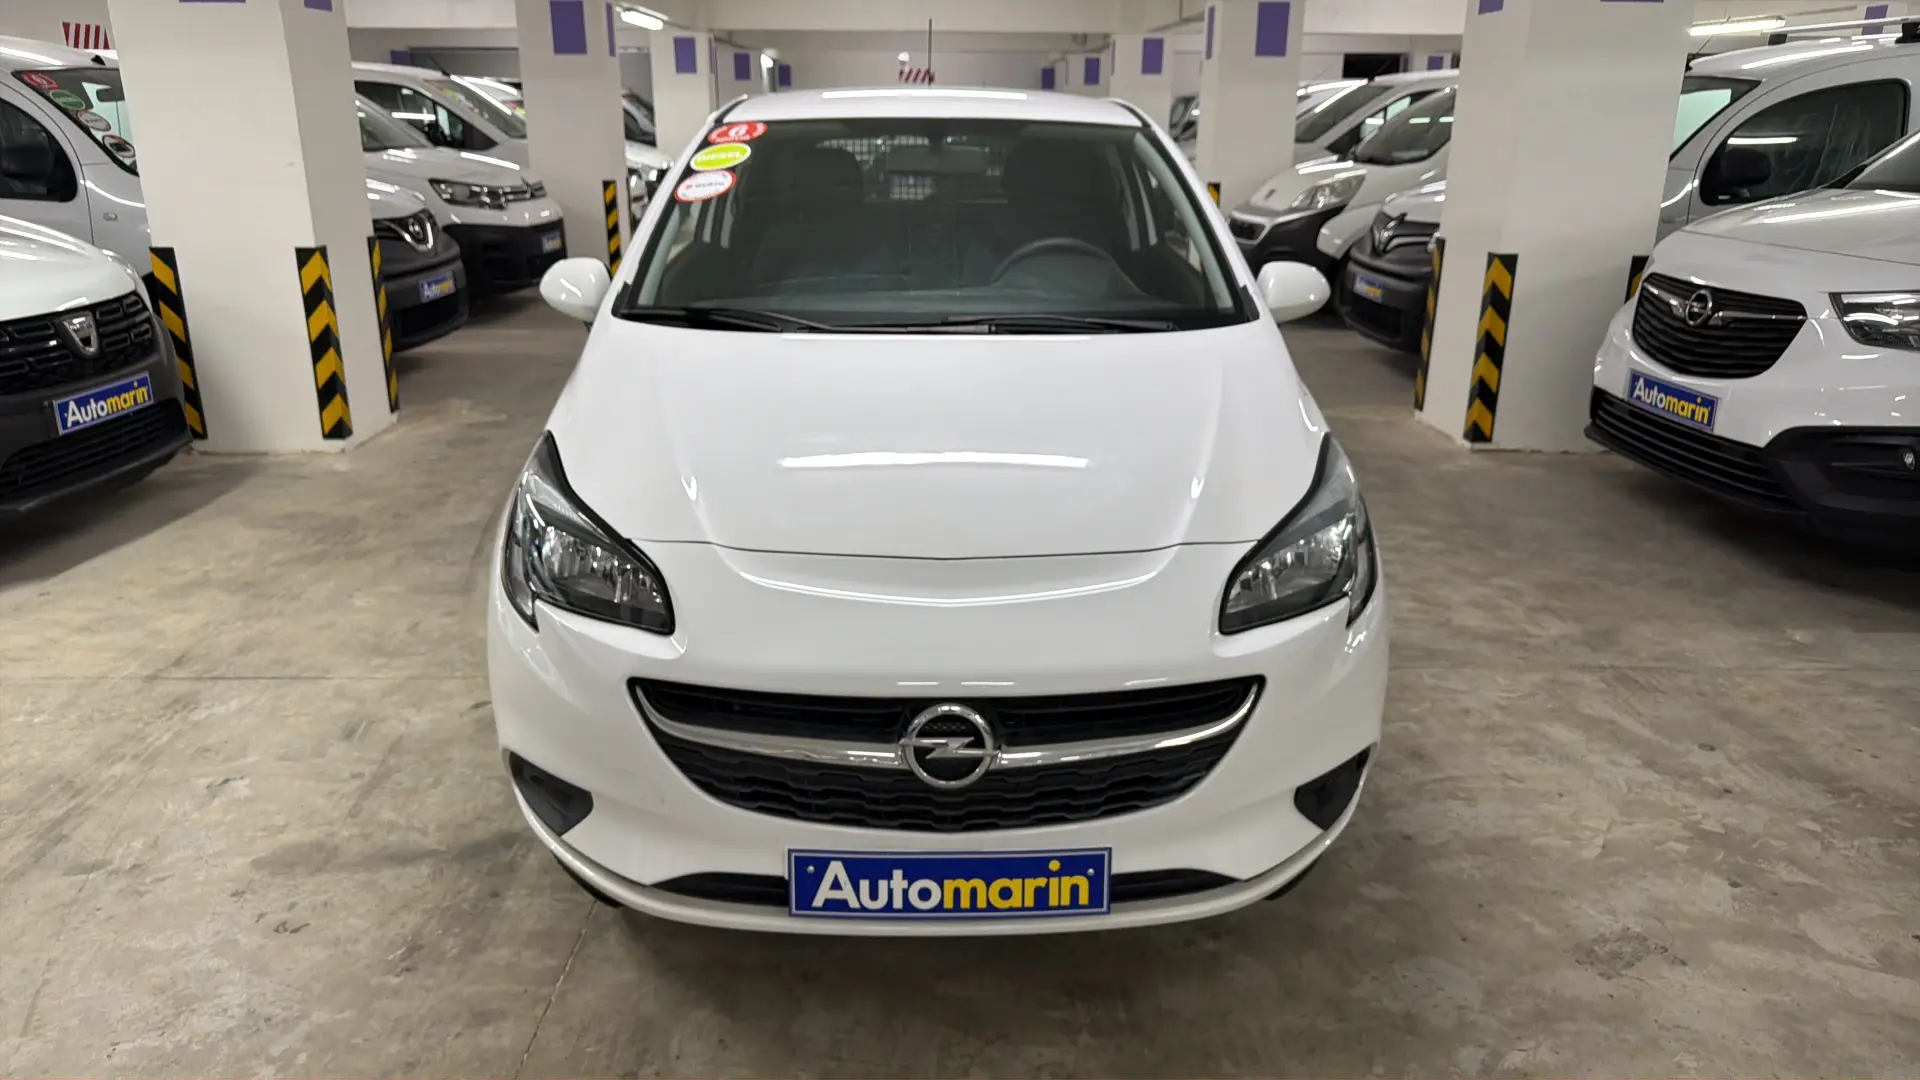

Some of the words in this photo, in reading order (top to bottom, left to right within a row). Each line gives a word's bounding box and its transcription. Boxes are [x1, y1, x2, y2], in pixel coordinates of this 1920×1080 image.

[66, 381, 148, 428] Automarin
[1633, 377, 1709, 425] Automarin
[811, 860, 1089, 910] Automarin
